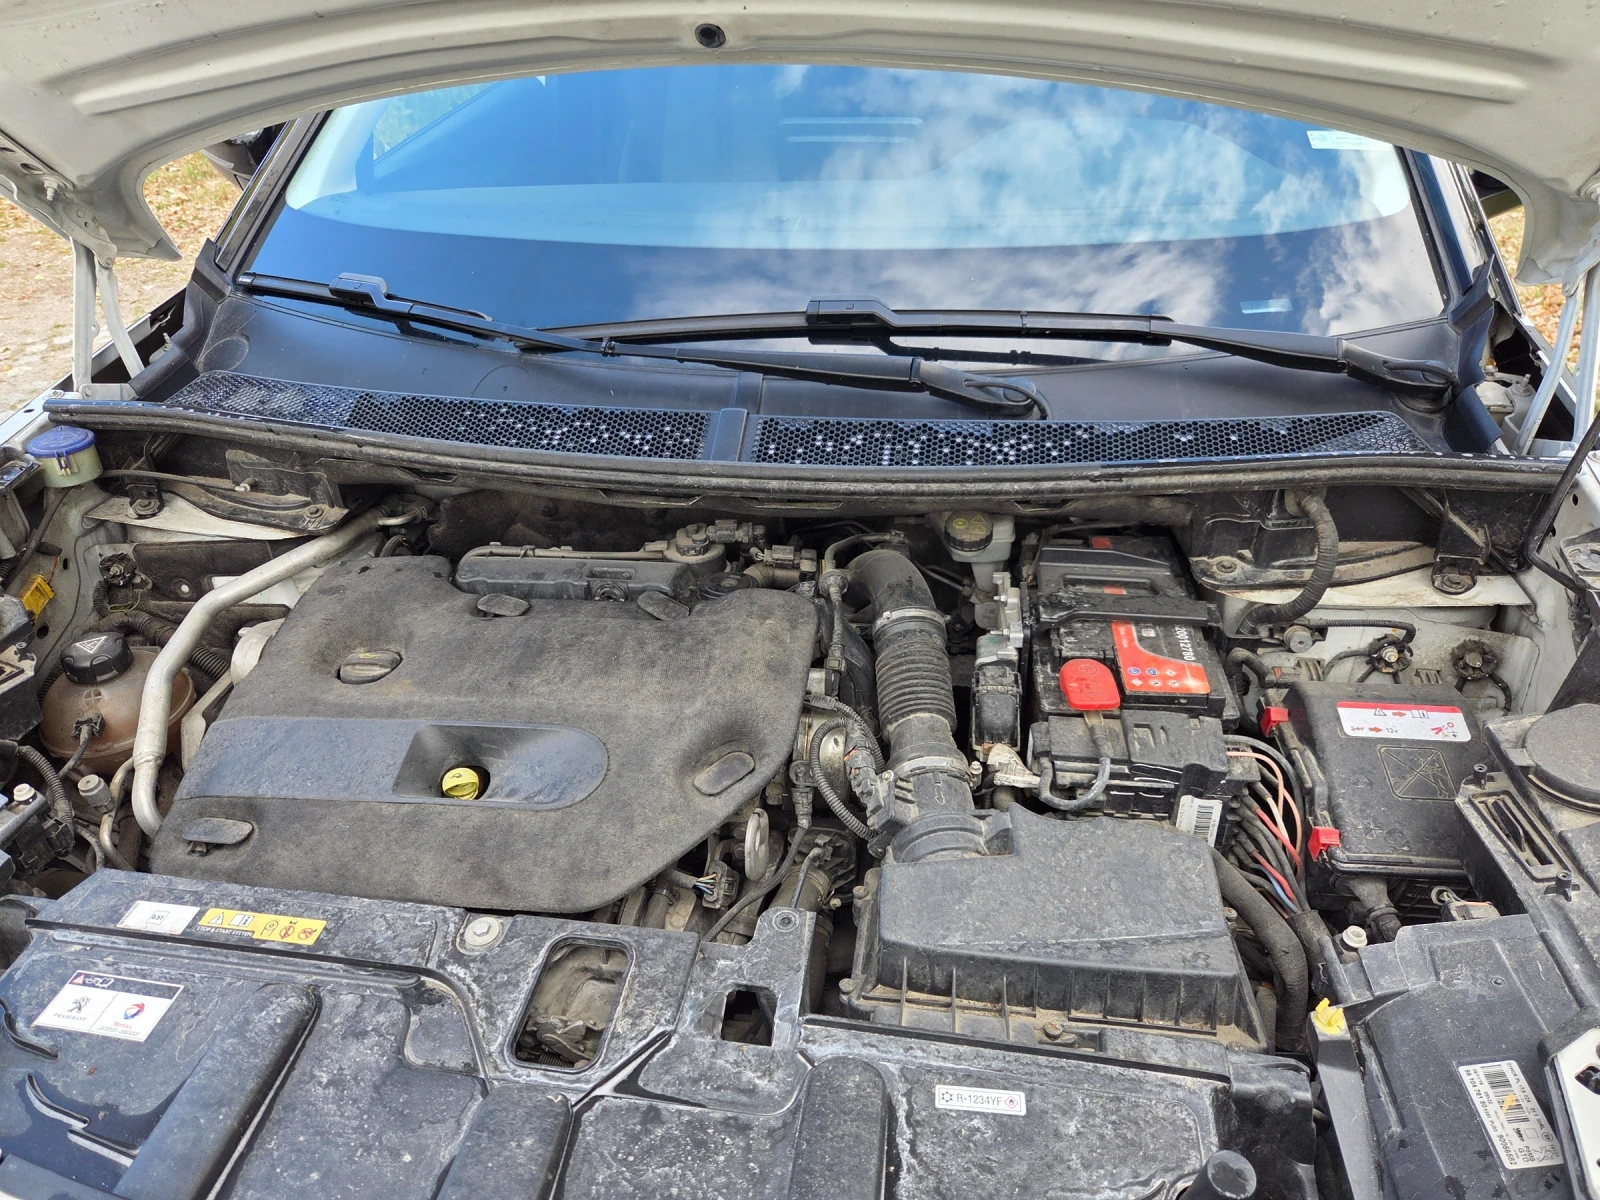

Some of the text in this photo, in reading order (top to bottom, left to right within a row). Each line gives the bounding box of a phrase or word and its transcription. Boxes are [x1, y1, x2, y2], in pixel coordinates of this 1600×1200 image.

[53, 1013, 87, 1022] PEUGEOT
[113, 1021, 133, 1030] TOTAL
[956, 1093, 1002, 1106] R-1234YF
